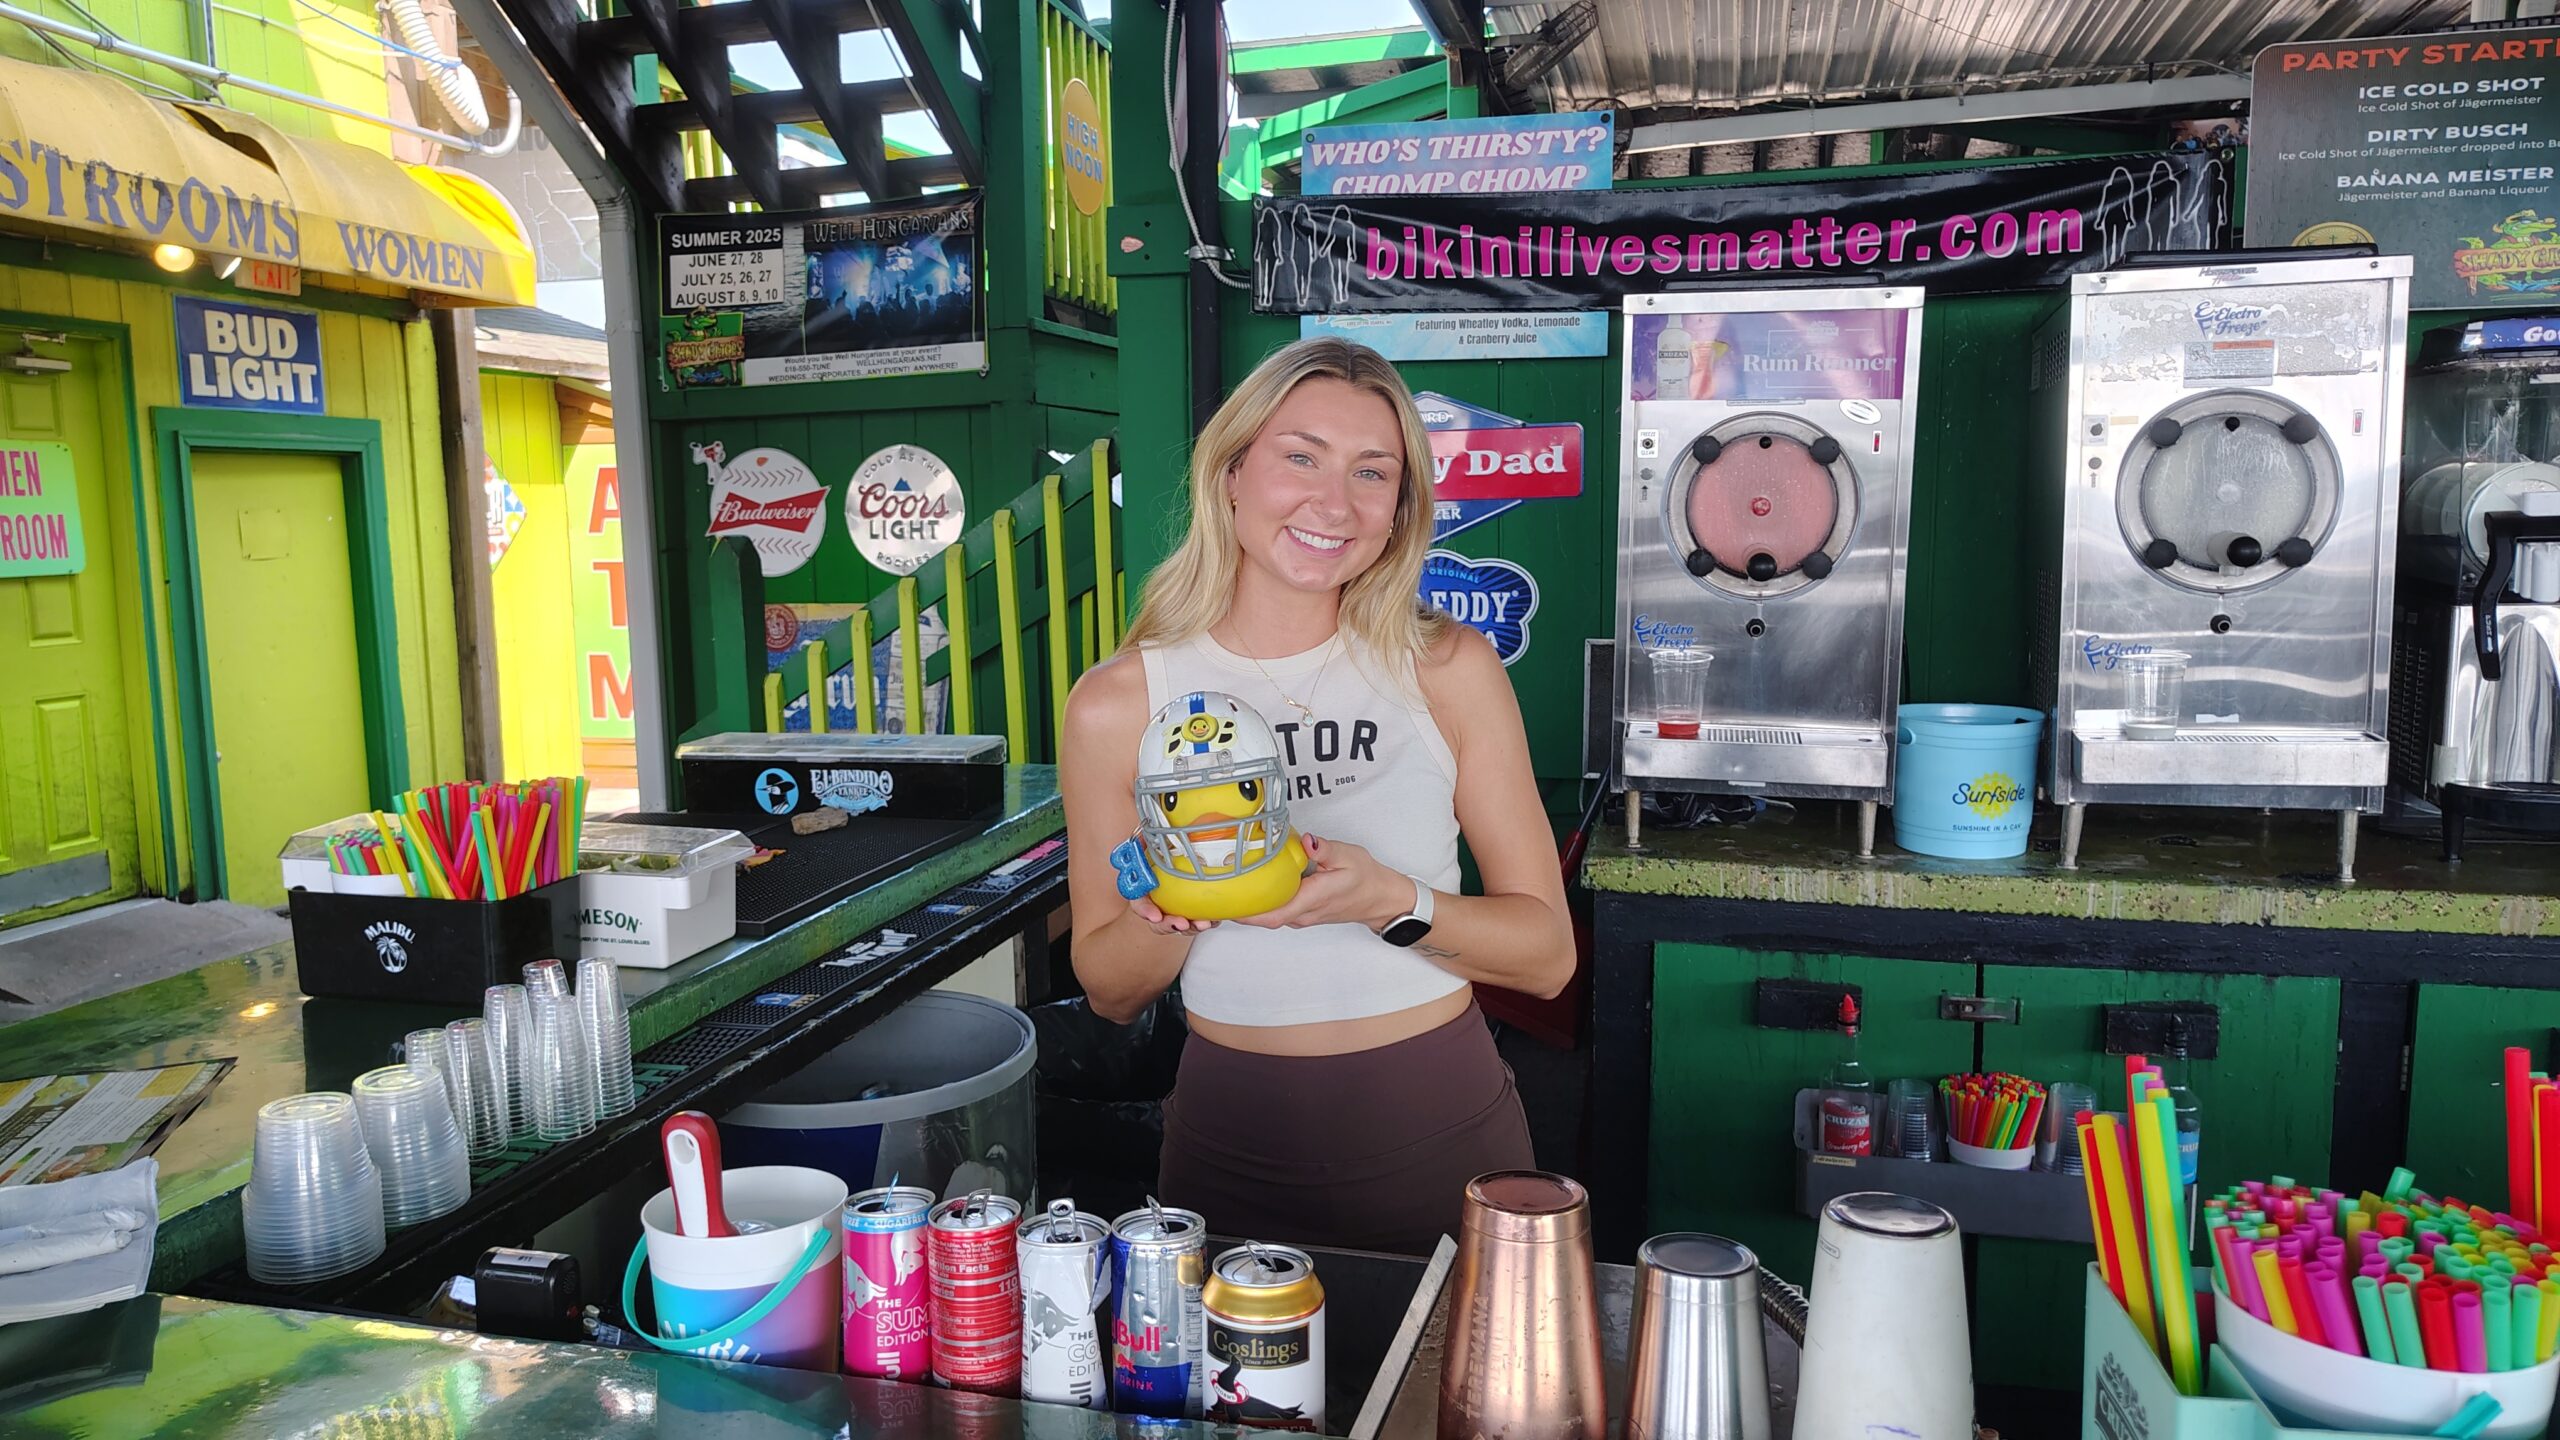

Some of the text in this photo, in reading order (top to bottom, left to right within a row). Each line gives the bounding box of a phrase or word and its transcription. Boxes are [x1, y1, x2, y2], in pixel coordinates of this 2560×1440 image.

[2283, 46, 2410, 73] PARTY
[2359, 76, 2546, 100] ICE COLD SHOT
[2358, 94, 2543, 113] Ice Cold Shot of Jägermeister
[1066, 111, 1099, 154] HIGH
[2367, 123, 2529, 143] DIRTY BUSCH
[1427, 125, 1608, 161] THIRSTY?
[2278, 151, 2296, 161] Ice
[2299, 150, 2326, 160] Cold
[2329, 149, 2357, 159] Shot
[2361, 147, 2375, 157] of
[2376, 143, 2457, 159] Jägermeister
[2460, 140, 2515, 155] dropped
[2519, 139, 2544, 150] into
[1064, 141, 1103, 184] NOON
[1332, 164, 1588, 194] CHOMP CHOMP
[2447, 166, 2554, 183] MEISTER
[0, 139, 299, 261] STROOMS
[2337, 184, 2550, 202] Jägermeister and Banana Liqueur
[671, 228, 782, 249] SUMMER 2025
[1366, 208, 2083, 280] bikinilivesmatter.com
[336, 219, 484, 291] WOMEN
[689, 251, 764, 268] JUNE 27, 28
[2461, 250, 2530, 272] SHADY
[681, 270, 772, 287] JULY 25, 26, 27
[675, 288, 778, 306] AUGUST 8, 9, 10
[1415, 315, 1580, 331] Featuring Wheatley Vodka, Lemonade
[2214, 307, 2263, 321] Electro
[204, 309, 298, 360] BUD
[2215, 320, 2261, 336] Freeze
[1458, 332, 1537, 346] & Cranberry Juice
[1743, 352, 1897, 373] Rum Runner
[189, 353, 317, 405] LIGHT
[863, 450, 942, 480] COLD AS THE
[1464, 445, 1567, 476] Dad
[859, 482, 950, 519] Coors
[716, 499, 818, 524] Budweiser
[869, 520, 940, 540] LIGHT
[876, 551, 931, 568] ROCKIES
[1429, 567, 1480, 584] ORIGINAL
[1430, 590, 1512, 623] EDDY
[1652, 622, 1694, 635] Electro
[1653, 635, 1694, 652] Freeze
[2104, 641, 2152, 657] Electro
[1275, 719, 1378, 766] TOR
[1335, 775, 1356, 786] 2006
[838, 786, 869, 796] YANKEE
[1952, 783, 2026, 806] Surfside
[1952, 824, 1991, 832] SUNSHINE
[2009, 823, 2022, 831] CAN
[364, 920, 415, 943] MALIBU
[1825, 1114, 1867, 1127] CRUZAN
[873, 1213, 926, 1229] SUGARFREE
[959, 1263, 990, 1273] Facts
[998, 1276, 1018, 1292] 110
[876, 1298, 902, 1309] THE
[876, 1303, 930, 1333] SUM
[877, 1327, 929, 1347] EDITION
[1069, 1329, 1094, 1341] THE
[1117, 1319, 1160, 1352] Bull
[1068, 1340, 1100, 1363] CO
[1213, 1330, 1299, 1364] Goslings
[1119, 1374, 1154, 1392] DRINK
